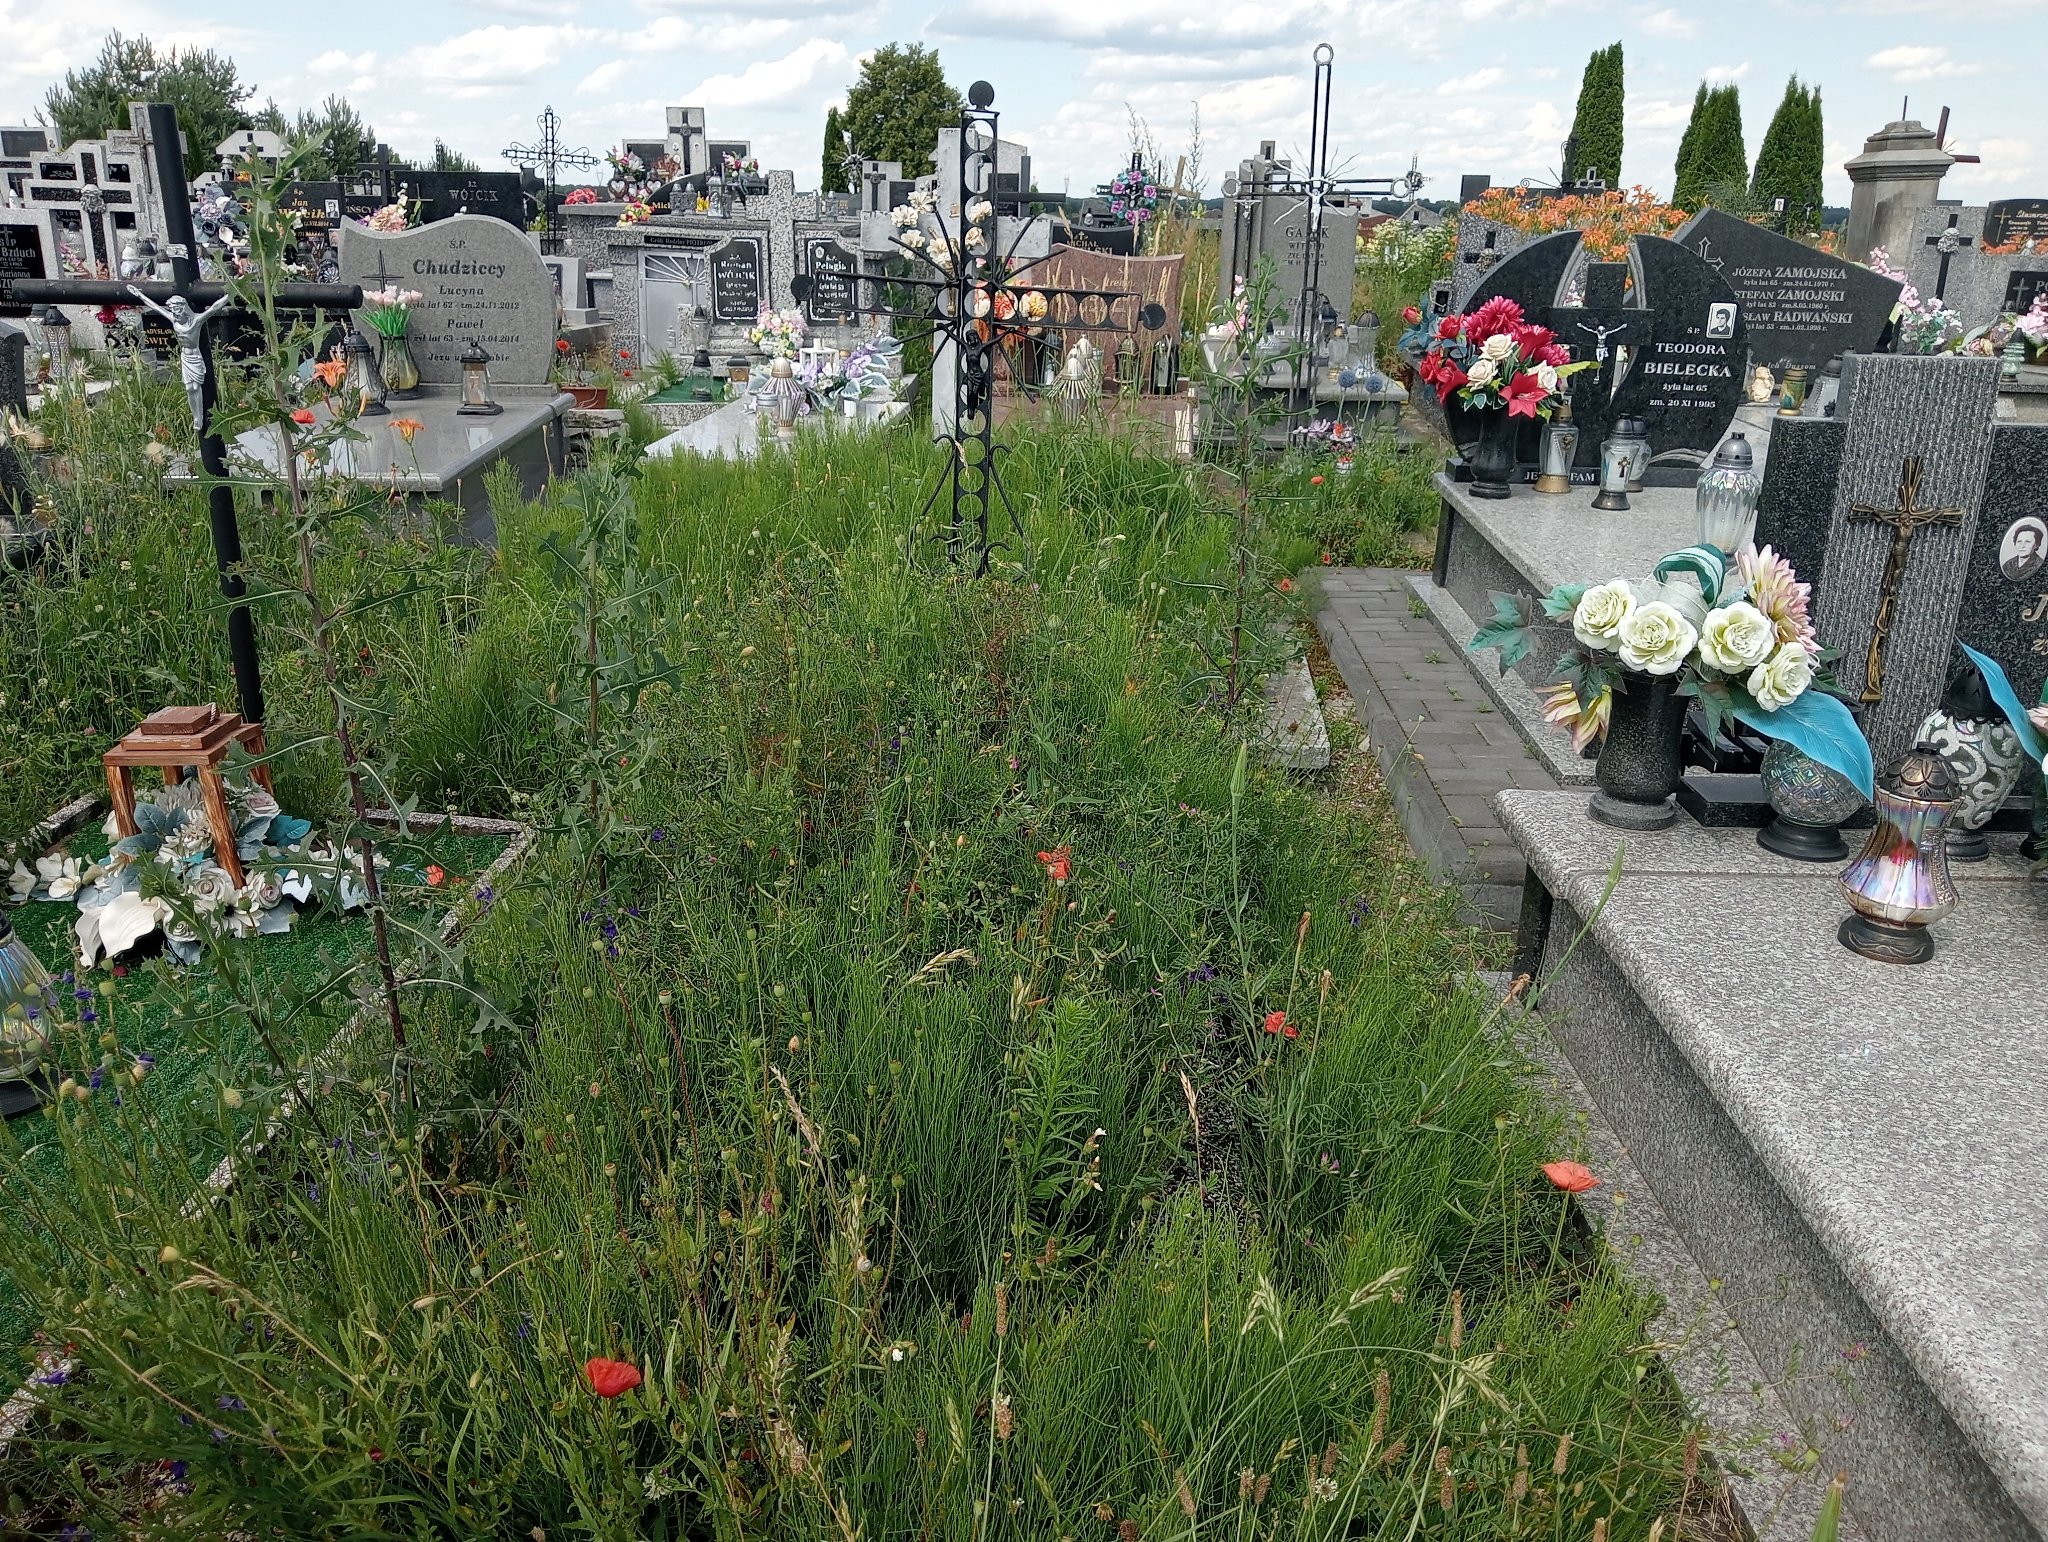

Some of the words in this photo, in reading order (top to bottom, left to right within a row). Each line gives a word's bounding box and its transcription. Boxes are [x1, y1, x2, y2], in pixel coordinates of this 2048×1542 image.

[1732, 265, 1772, 278] JÓZEFA
[1775, 266, 1848, 280] ZAMOJSKA
[438, 284, 485, 298] Lucyna
[1734, 290, 1775, 300] STEFAN
[1777, 289, 1846, 302] ZAMOJSKI
[428, 300, 441, 310] lat
[443, 301, 454, 310] 62
[1773, 310, 1854, 324] RADWAŃSKI
[428, 334, 441, 343] lat
[1655, 342, 1726, 355] TEODORA
[489, 353, 511, 362] obie
[1643, 361, 1732, 378] BIELECKA
[1662, 382, 1681, 392] żyła
[1682, 383, 1694, 392] lat
[1696, 383, 1708, 392] 65
[1667, 399, 1680, 407] 20
[1680, 399, 1691, 407] XI
[1694, 400, 1716, 409] 1995
[1568, 471, 1595, 482] FAM
